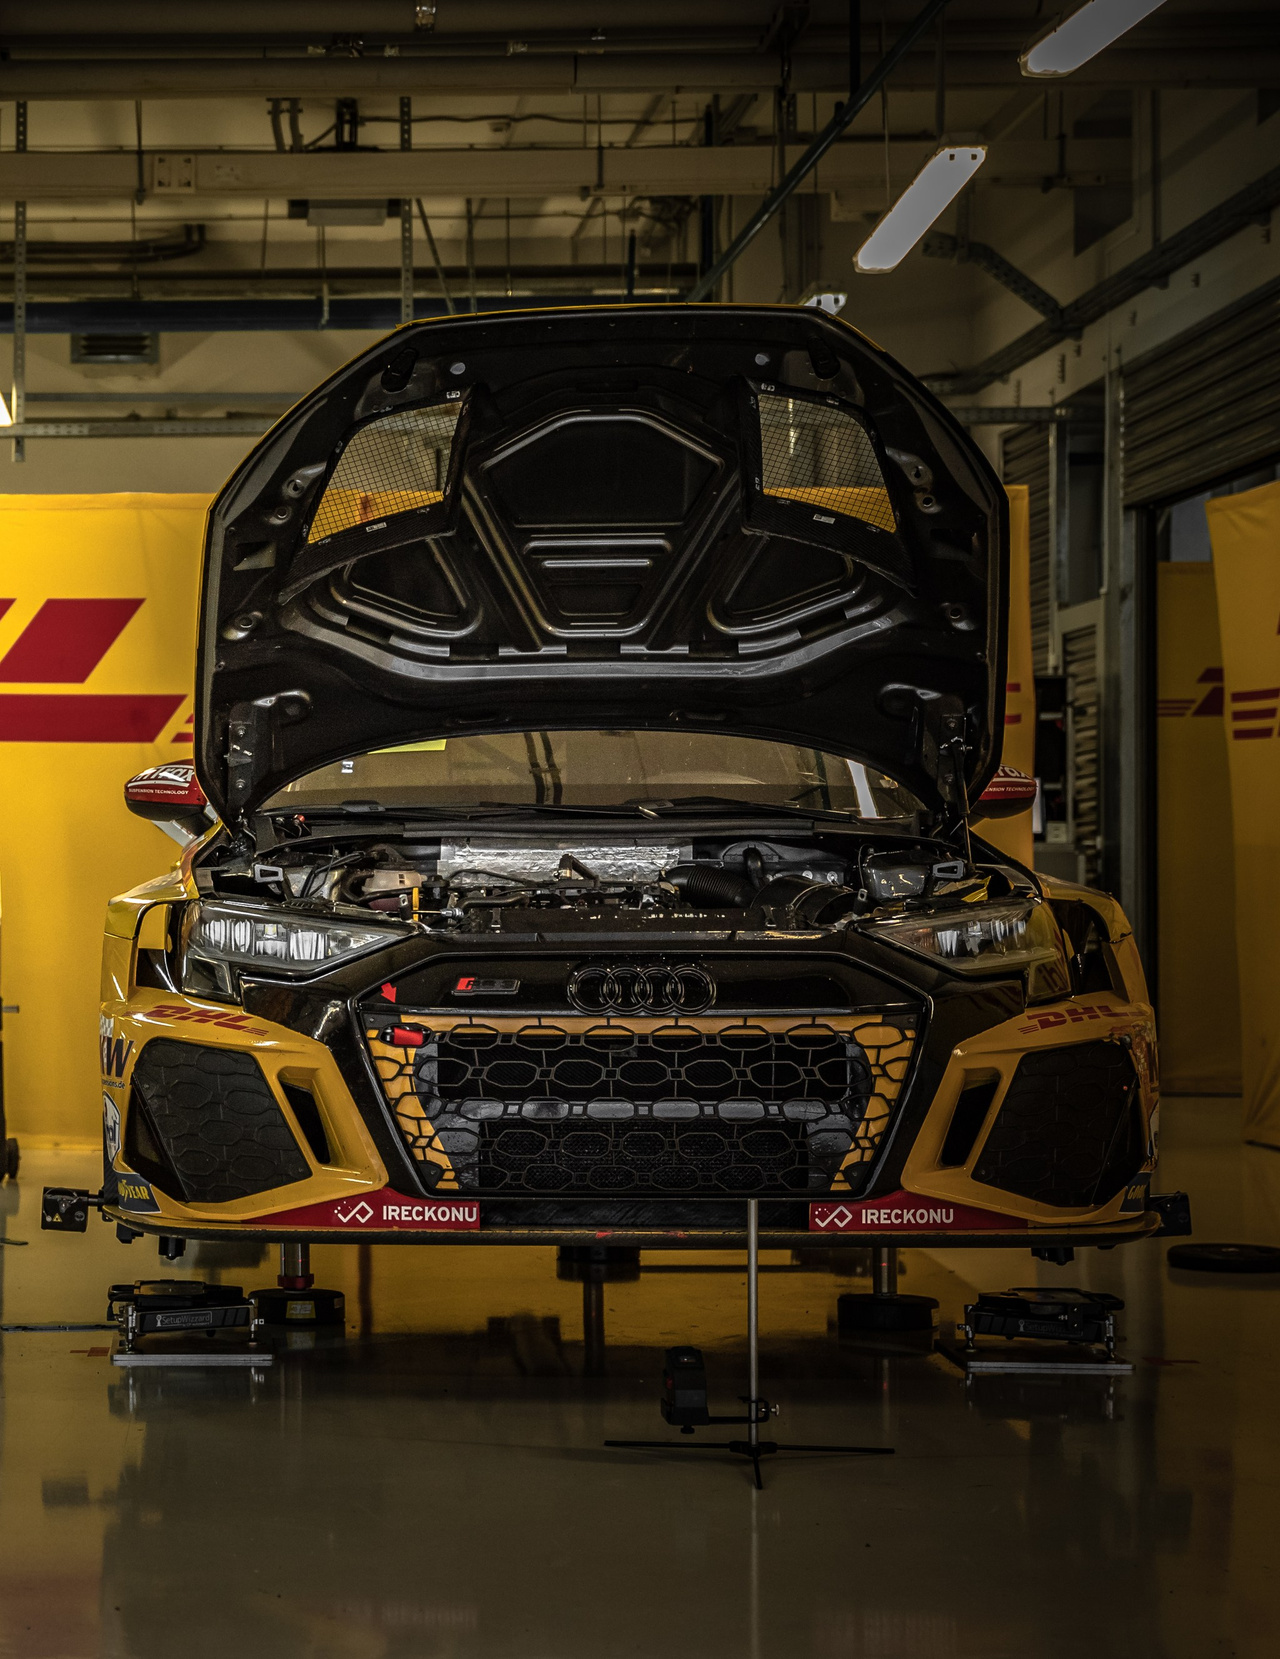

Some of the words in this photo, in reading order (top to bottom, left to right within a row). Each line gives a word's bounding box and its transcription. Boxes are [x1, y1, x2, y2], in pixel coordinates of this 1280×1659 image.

[144, 1004, 253, 1031] DHL
[1026, 1005, 1130, 1029] DHL
[382, 1205, 478, 1222] IRECKONU
[861, 1208, 954, 1224] IRECKONU
[162, 1314, 210, 1325] SetupWizzard
